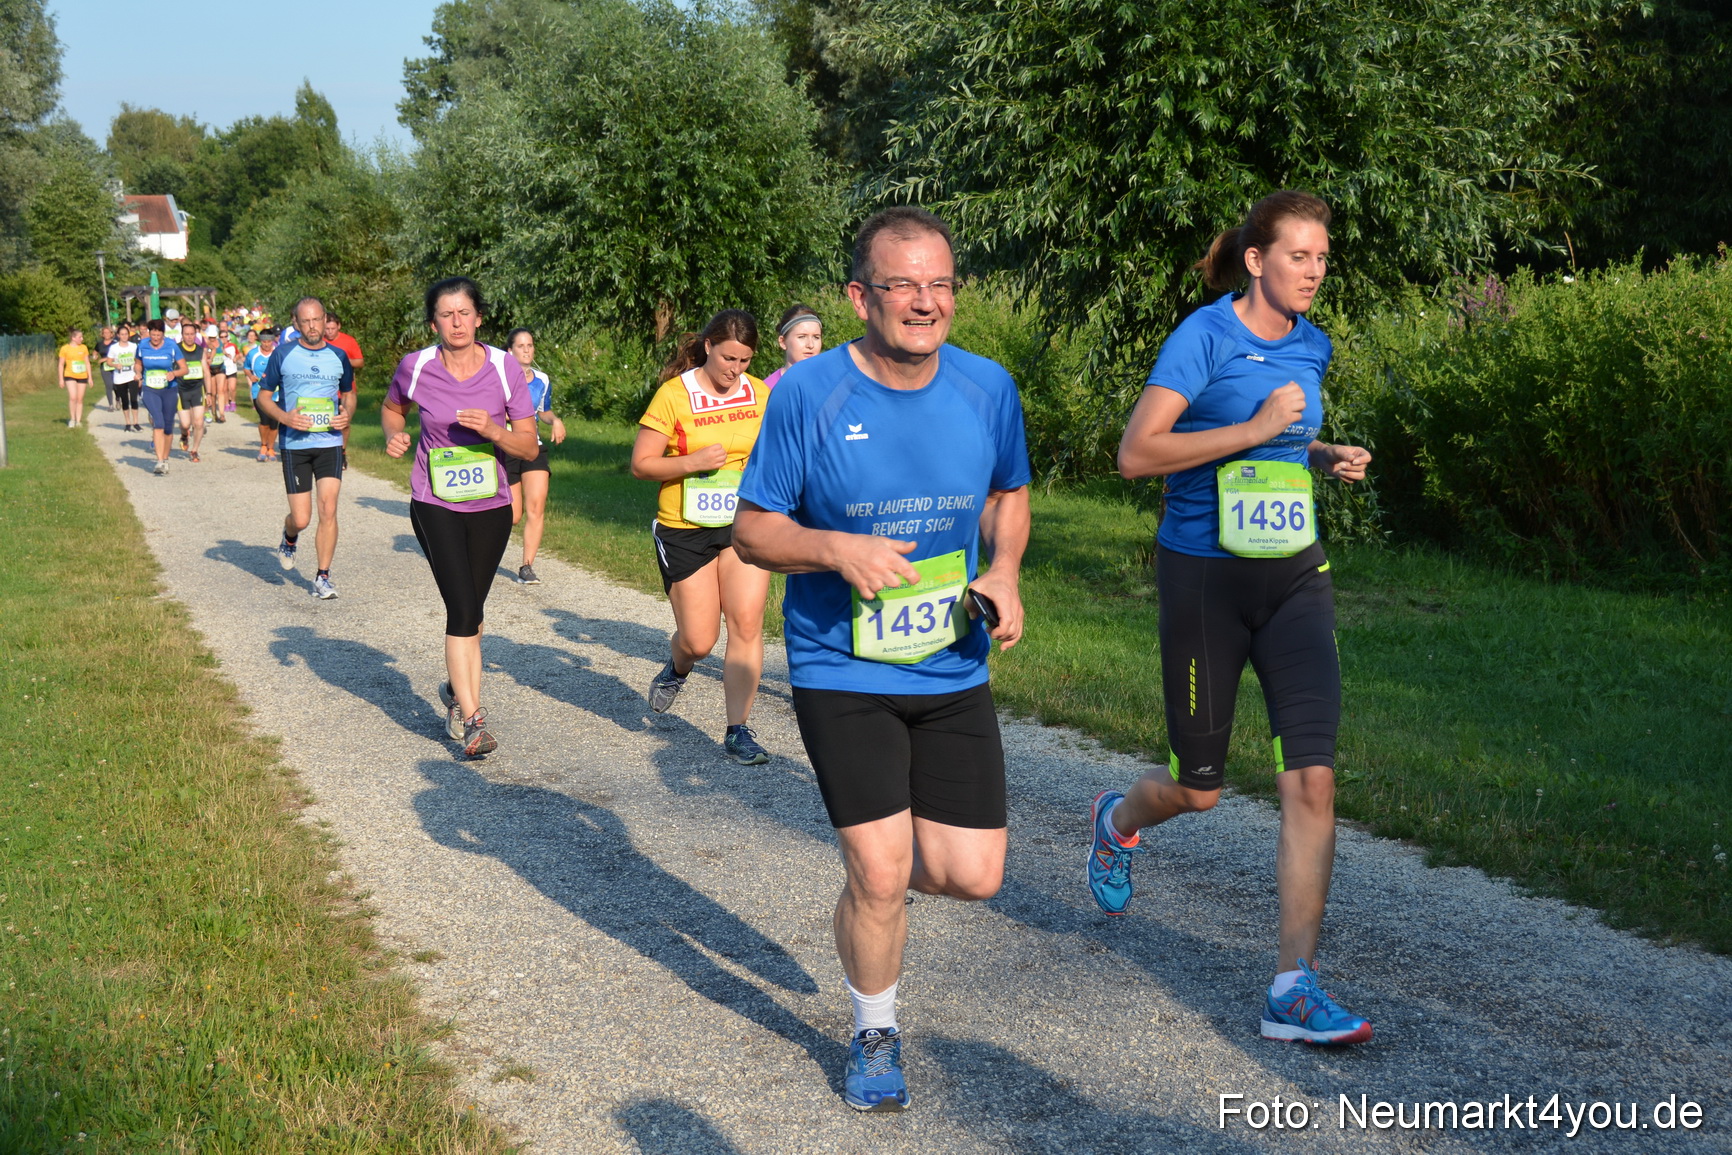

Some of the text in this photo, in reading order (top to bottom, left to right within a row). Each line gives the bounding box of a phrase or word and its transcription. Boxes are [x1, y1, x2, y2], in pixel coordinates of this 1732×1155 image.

[693, 409, 759, 427] MAX BÖGL
[444, 466, 485, 488] 298
[697, 492, 736, 512] 886
[846, 494, 976, 518] WER LAUFEND DENKT,
[1231, 499, 1306, 532] 1436
[872, 517, 956, 537] BEWEGT SICH
[867, 595, 958, 641] 1437
[882, 644, 912, 654] Andreas
[912, 636, 947, 649] Schneider
